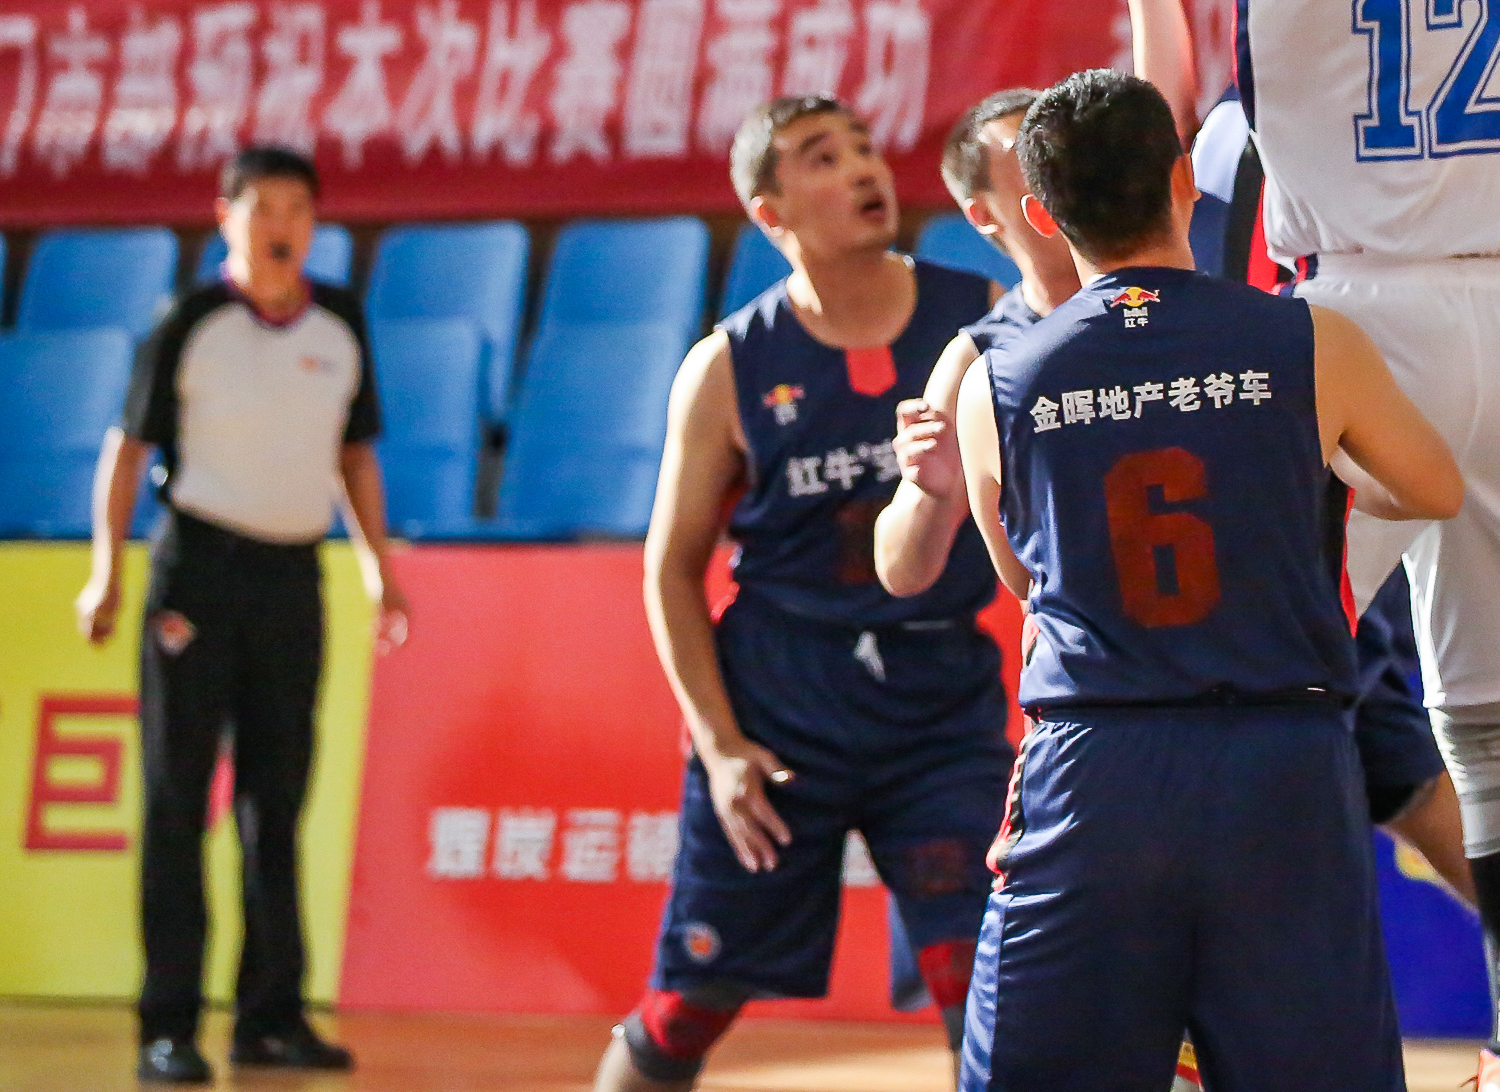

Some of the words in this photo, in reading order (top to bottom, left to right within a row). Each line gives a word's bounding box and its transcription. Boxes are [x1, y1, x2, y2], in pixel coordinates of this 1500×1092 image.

[1030, 369, 1272, 434] 金晖地产老爷车
[1103, 445, 1221, 630] 6
